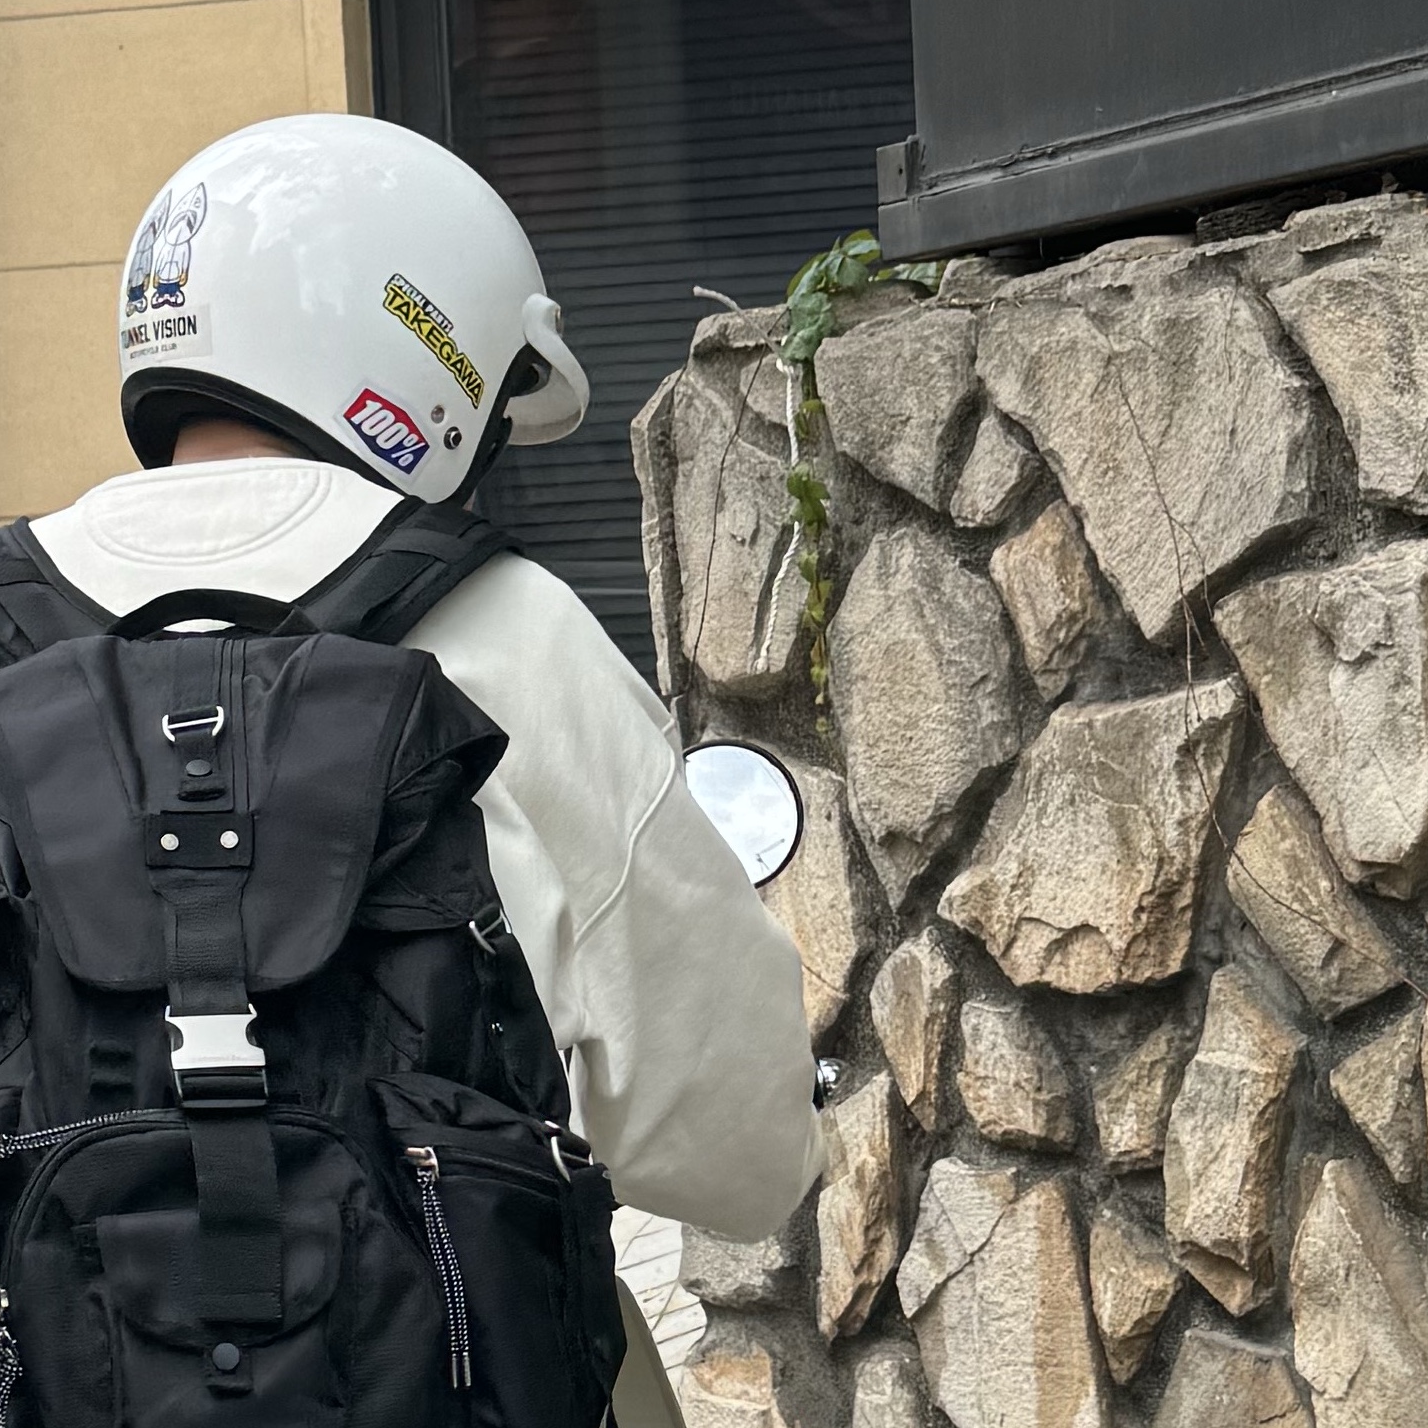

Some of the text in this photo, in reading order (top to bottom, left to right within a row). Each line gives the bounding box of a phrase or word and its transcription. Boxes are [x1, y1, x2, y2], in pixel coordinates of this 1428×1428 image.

[152, 315, 198, 341] VISION
[386, 289, 484, 404] TAKEGAWA
[350, 399, 426, 467] 100%
